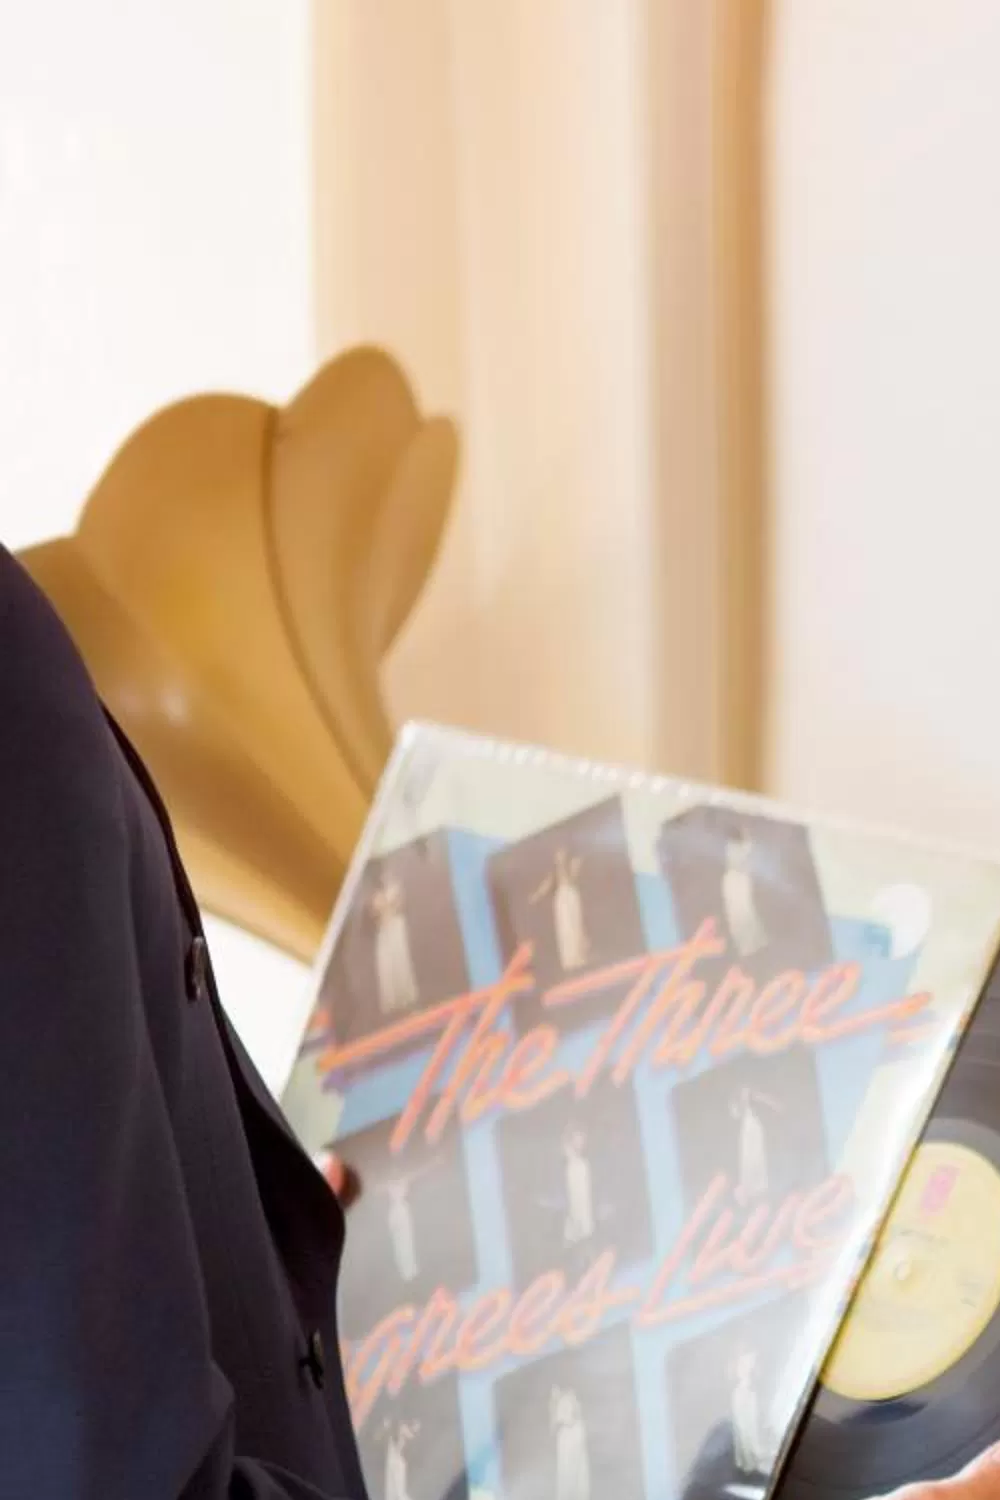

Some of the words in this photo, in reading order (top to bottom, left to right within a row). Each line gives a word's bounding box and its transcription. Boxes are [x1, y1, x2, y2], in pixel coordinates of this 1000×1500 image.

[318, 940, 570, 1153] The
[541, 917, 933, 1100] Three
[340, 1246, 642, 1430] grees
[634, 1172, 858, 1330] Live
